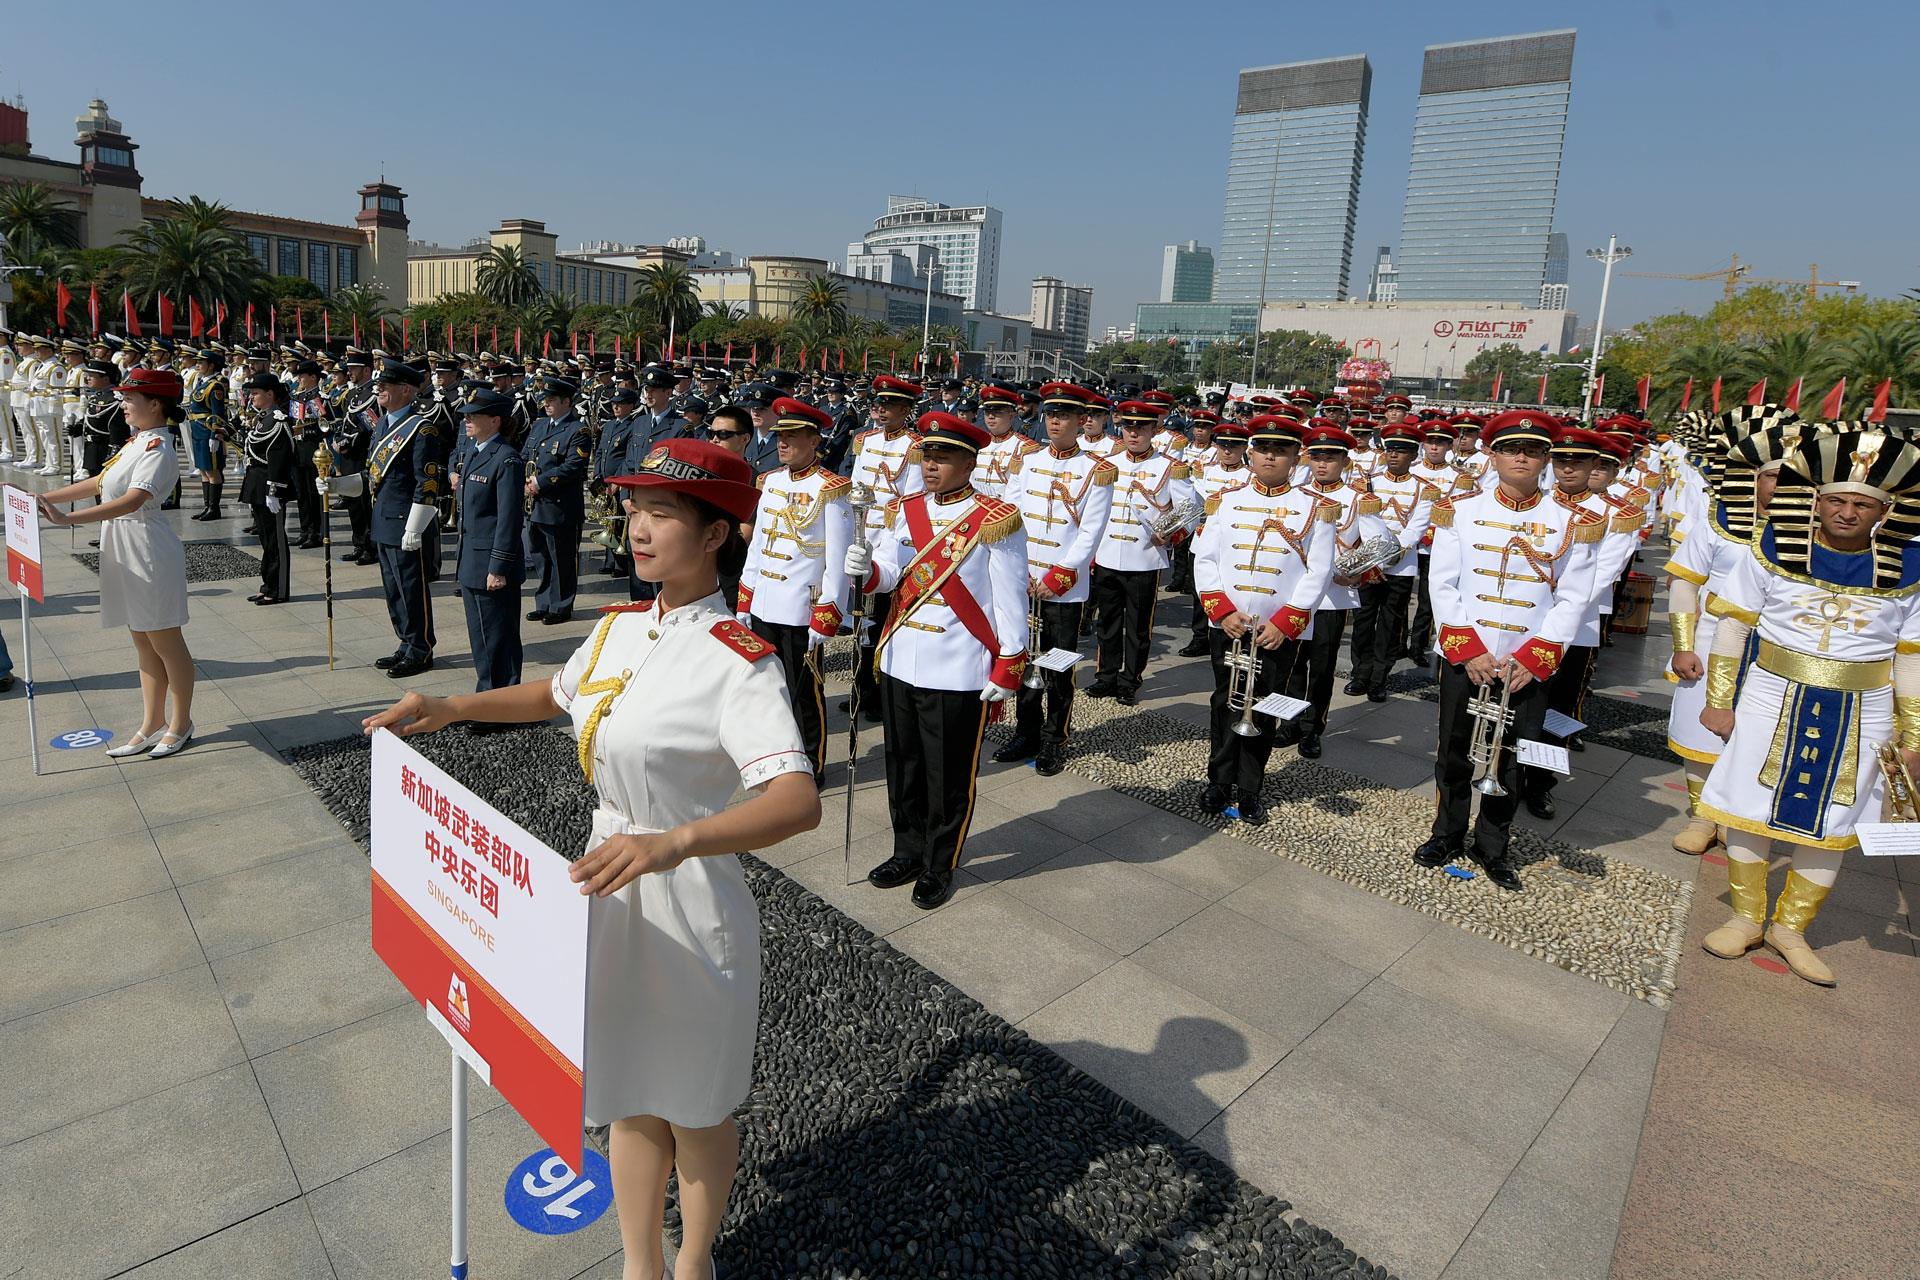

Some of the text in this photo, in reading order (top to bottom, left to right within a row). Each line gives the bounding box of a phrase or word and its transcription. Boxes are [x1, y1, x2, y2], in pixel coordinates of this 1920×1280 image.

[1457, 320, 1528, 333] 万达广场
[401, 764, 534, 898] 新加坡武装部队
[425, 830, 499, 919] 中央乐团
[427, 879, 495, 953] SINGAPORE
